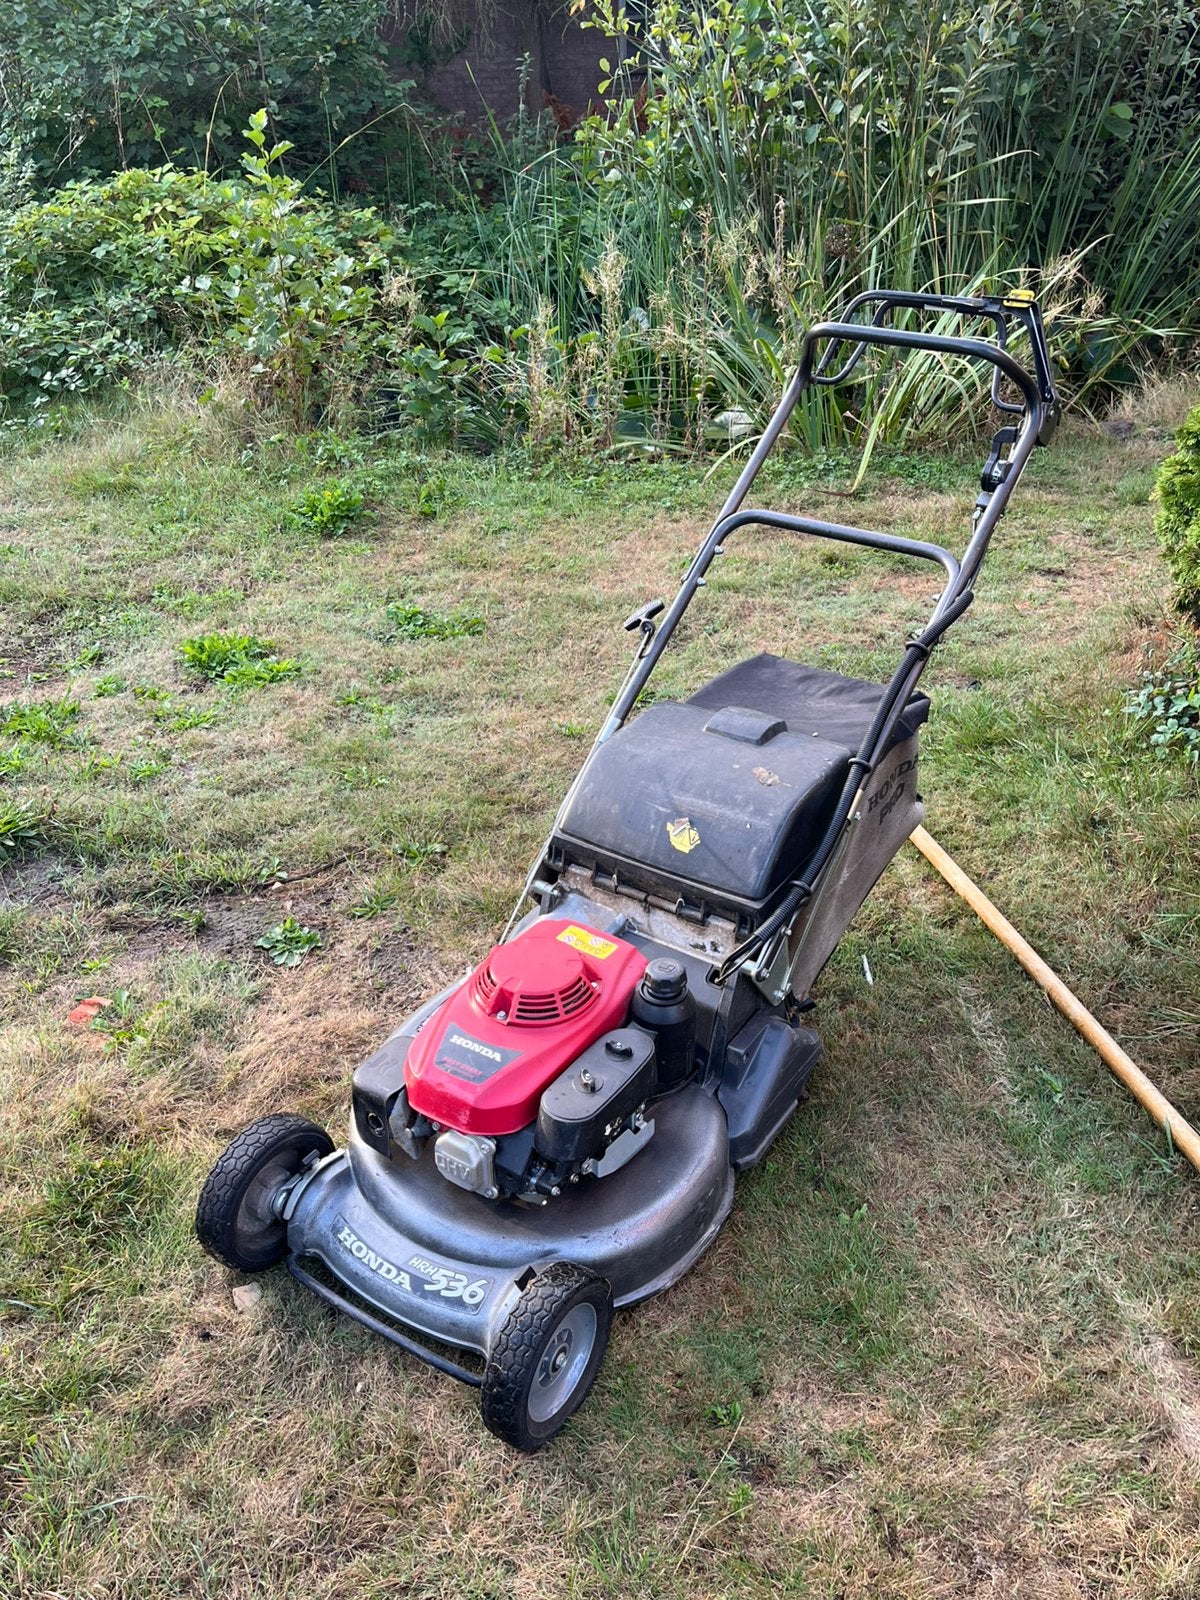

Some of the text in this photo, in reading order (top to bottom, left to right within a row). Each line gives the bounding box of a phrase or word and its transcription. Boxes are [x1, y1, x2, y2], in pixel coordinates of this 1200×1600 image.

[879, 781, 905, 825] PRO
[448, 1034, 502, 1062] HONDA
[337, 1226, 412, 1292] HONDA
[408, 1256, 488, 1305] HRH 536
